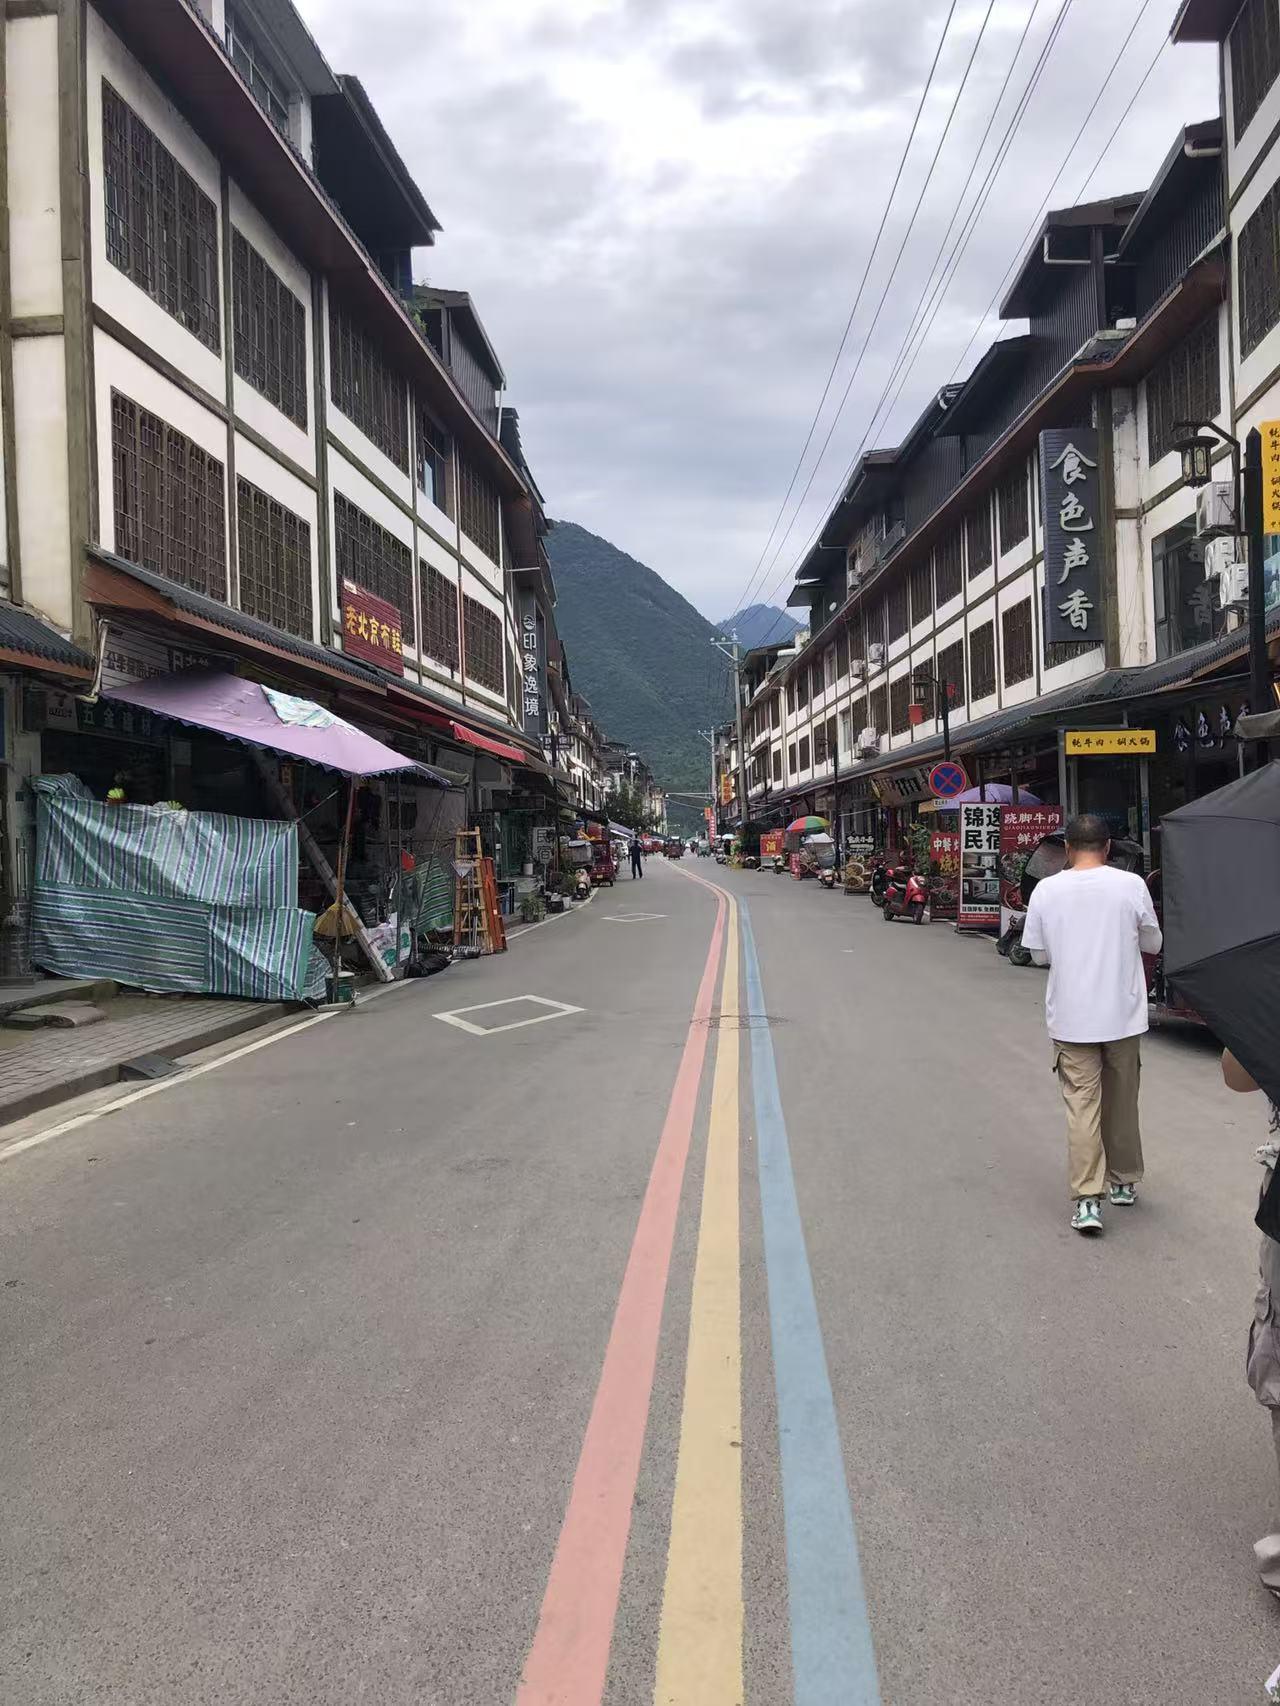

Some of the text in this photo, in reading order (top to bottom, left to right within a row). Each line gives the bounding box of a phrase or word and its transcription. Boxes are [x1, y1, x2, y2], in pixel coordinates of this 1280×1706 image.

[1050, 442, 1098, 632] 食色声香
[346, 604, 402, 656] 老北京布鞋
[522, 632, 539, 717] 印象逸境
[964, 806, 1000, 828] 锦逸
[1004, 812, 1060, 825] 跷脚牛肉
[964, 830, 1000, 851] 民宿
